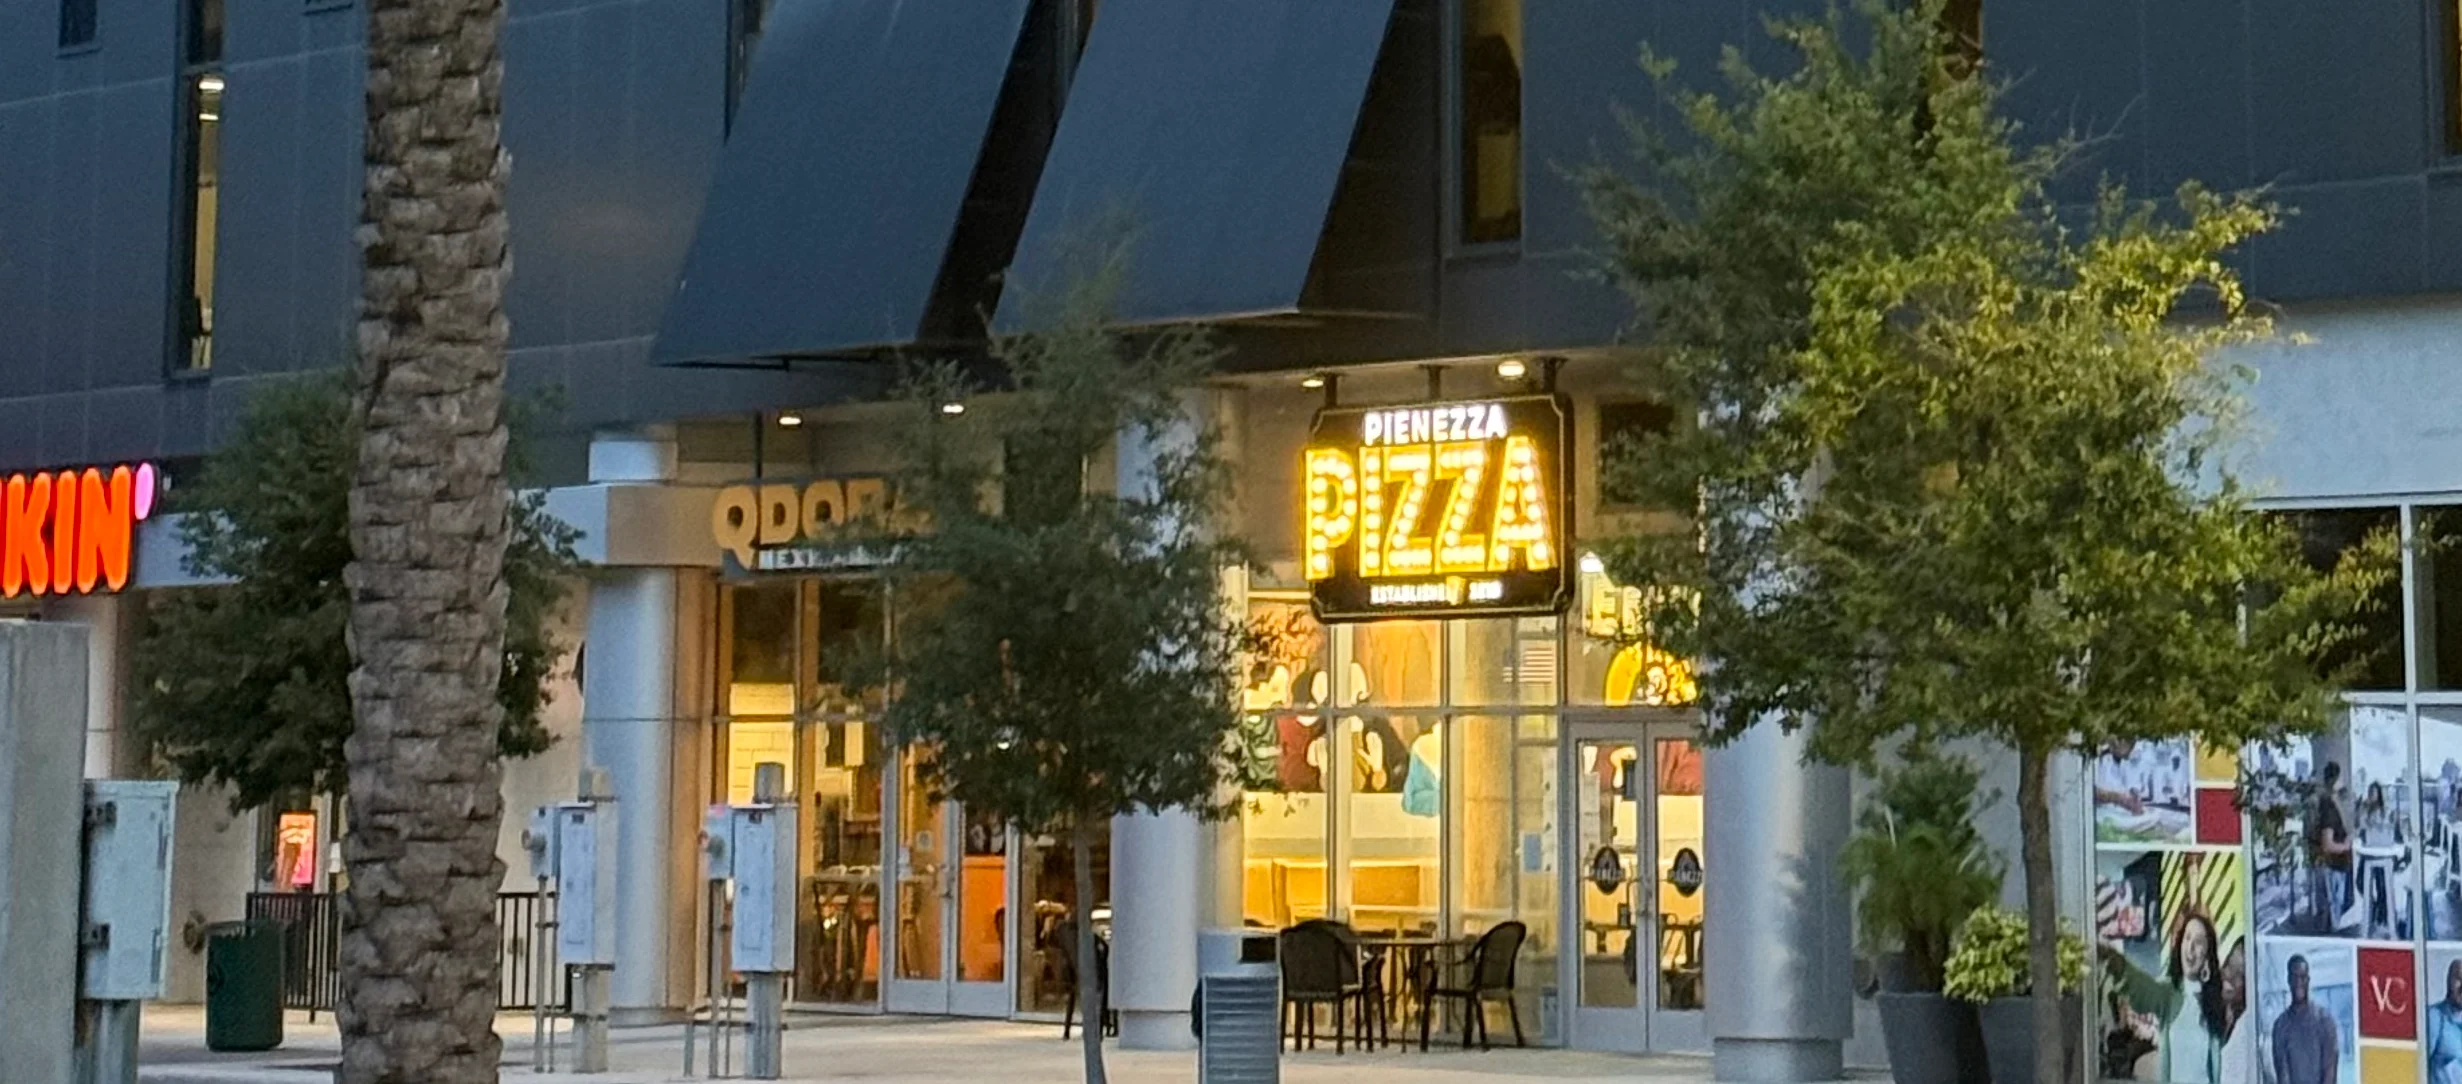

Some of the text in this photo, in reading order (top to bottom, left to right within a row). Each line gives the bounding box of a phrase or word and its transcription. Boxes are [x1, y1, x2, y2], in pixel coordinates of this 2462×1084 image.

[1363, 404, 1508, 447] PIENEZZA
[1305, 435, 1558, 580] PIZZA
[0, 462, 155, 599] KIN'
[1370, 581, 1456, 605] ESTABLISHE
[2370, 974, 2407, 1015] VC
